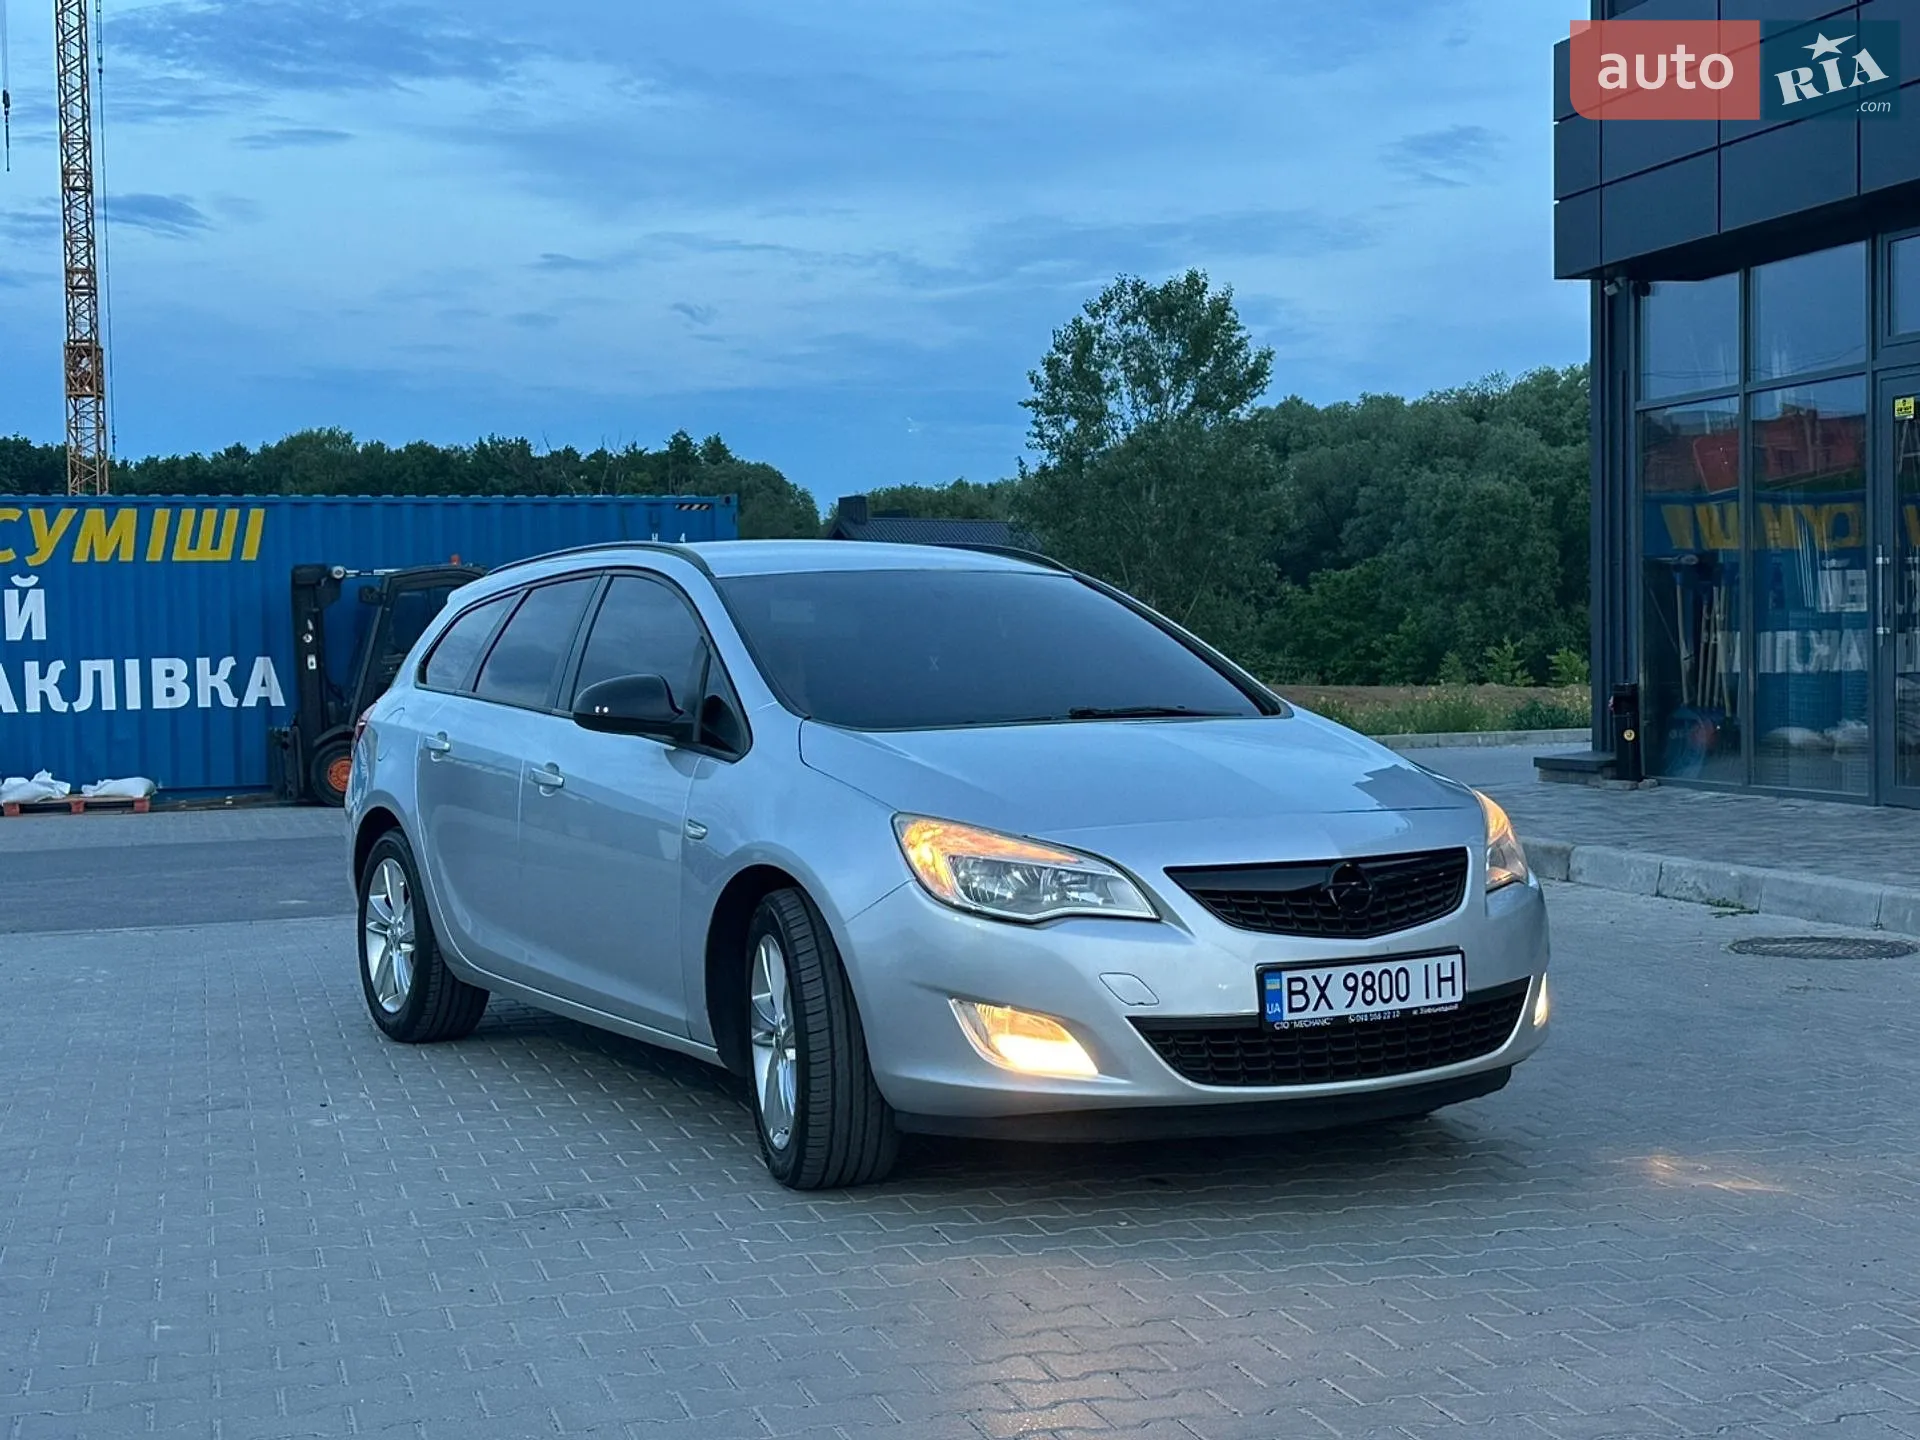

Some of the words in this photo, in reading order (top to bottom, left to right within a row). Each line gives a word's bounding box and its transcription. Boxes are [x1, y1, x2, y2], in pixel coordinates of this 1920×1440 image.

[4, 574, 47, 641] Й
[1266, 1003, 1282, 1015] UA
[1286, 973, 1334, 1014] BX
[1342, 966, 1410, 1009] 9800
[1424, 961, 1456, 999] IH
